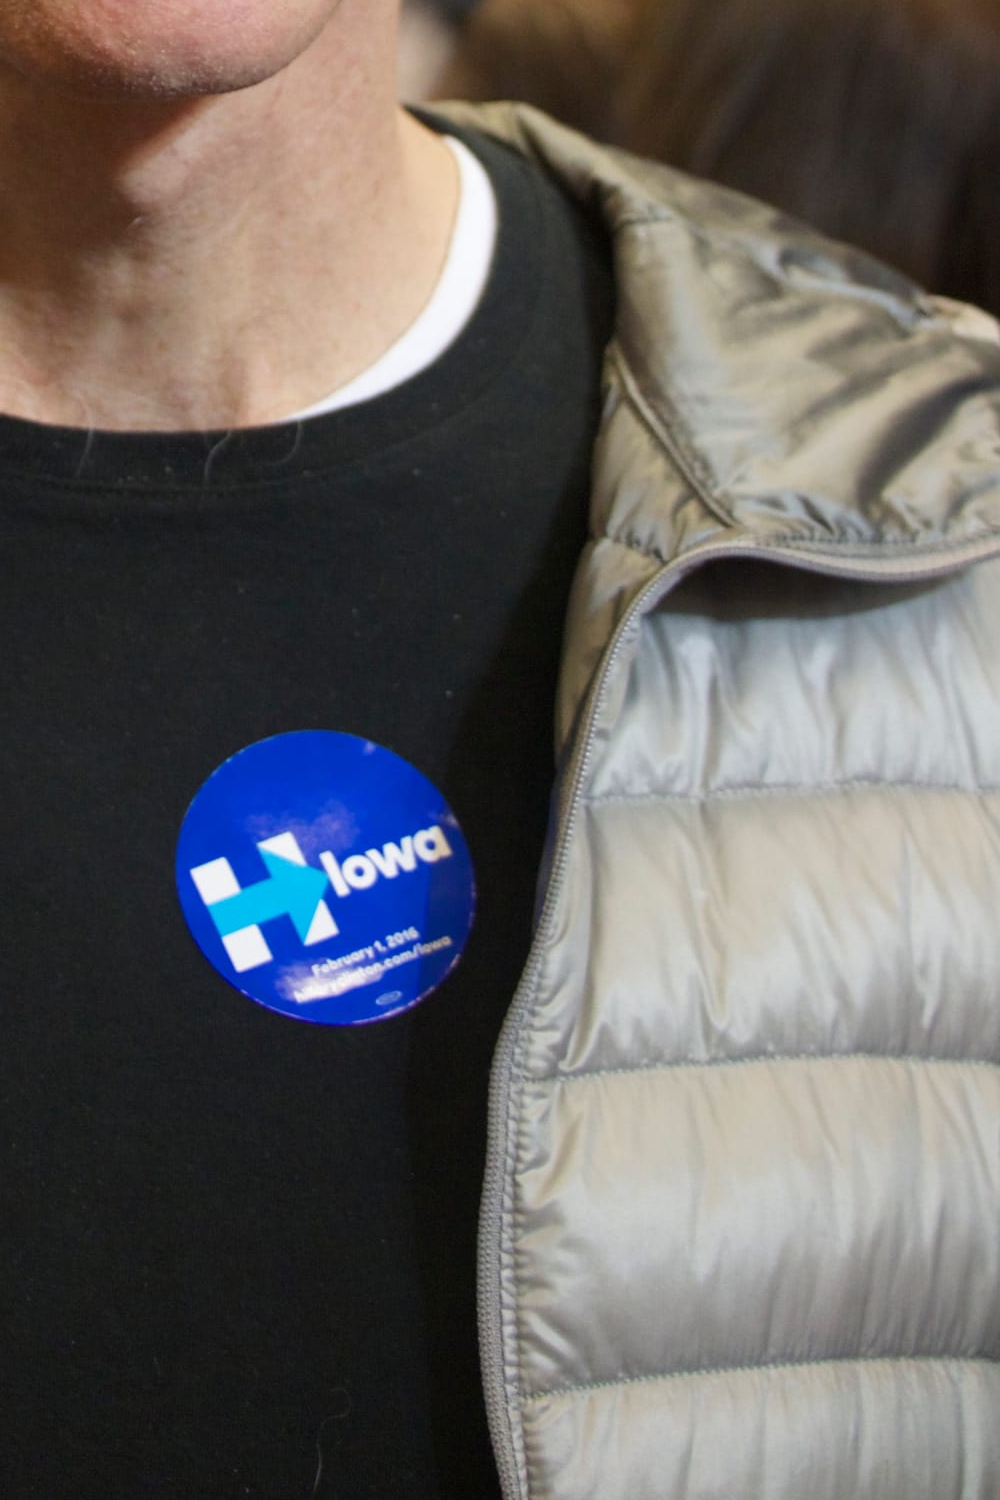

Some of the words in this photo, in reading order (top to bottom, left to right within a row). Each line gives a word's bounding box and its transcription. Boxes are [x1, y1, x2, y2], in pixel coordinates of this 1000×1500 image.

[319, 825, 453, 898] Iowa
[311, 944, 376, 977] February
[374, 940, 387, 953] 1,
[385, 926, 420, 948] 2016
